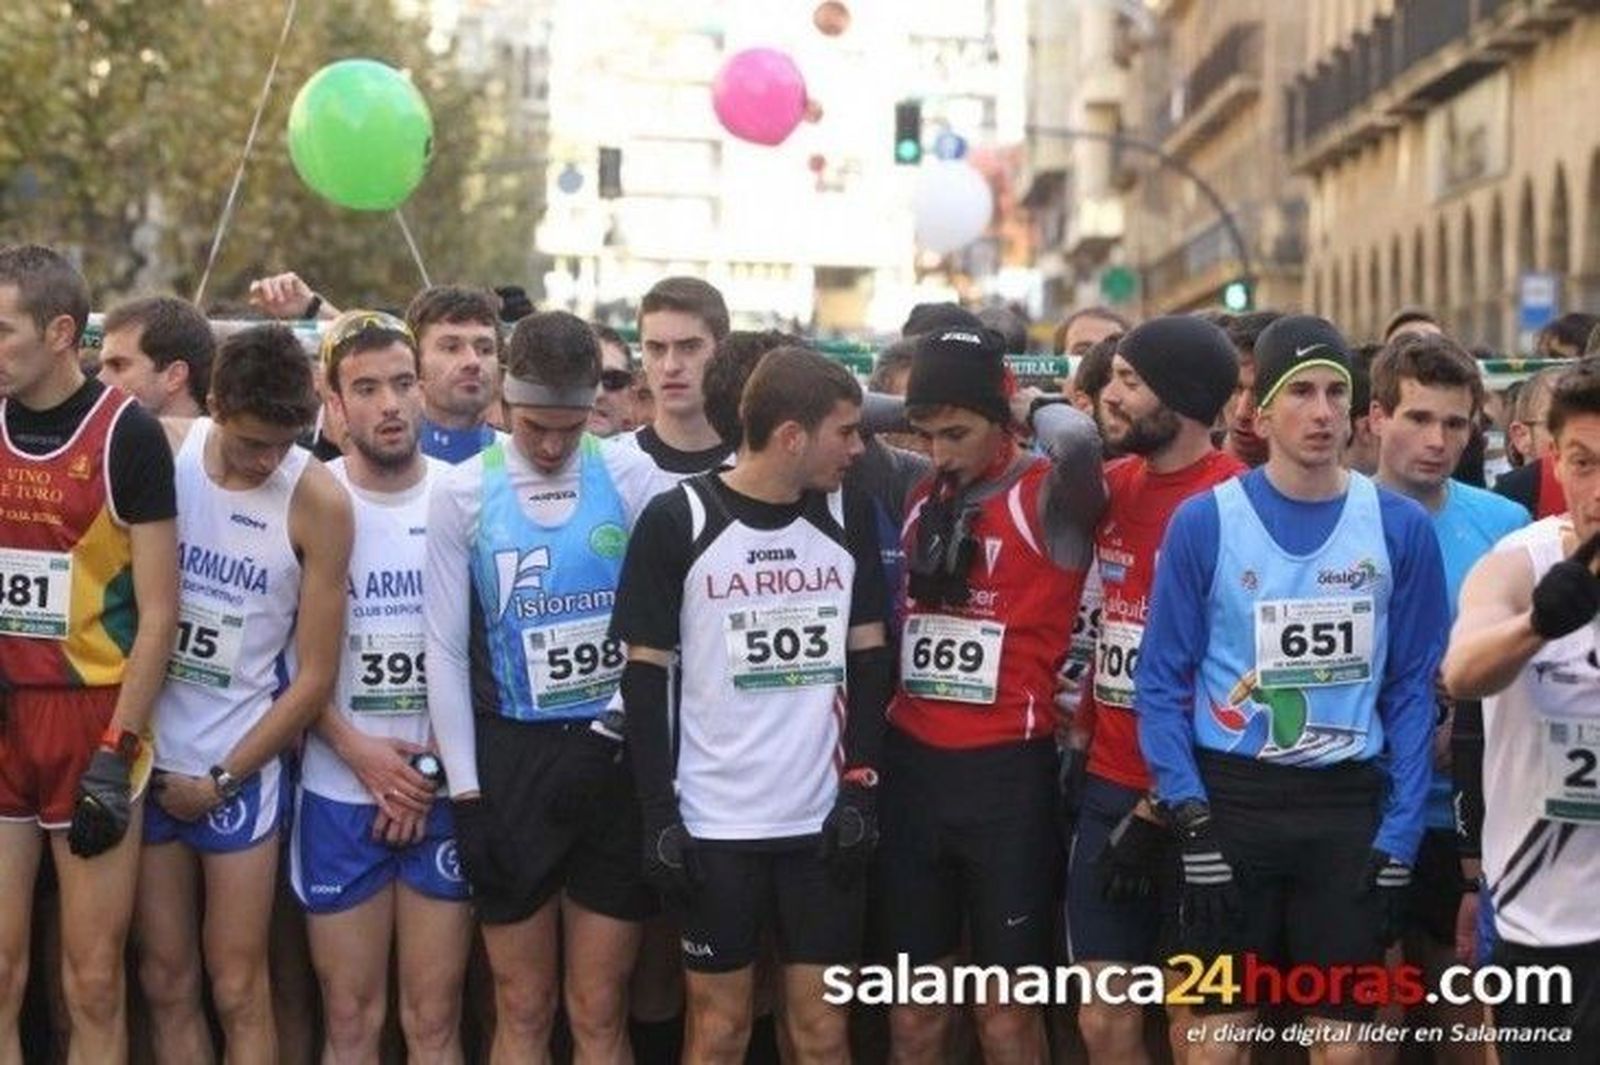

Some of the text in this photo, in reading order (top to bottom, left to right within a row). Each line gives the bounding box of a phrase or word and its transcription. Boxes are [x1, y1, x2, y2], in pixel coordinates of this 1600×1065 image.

[15, 485, 63, 502] TORO
[706, 566, 844, 599] LA RIOJA
[745, 625, 829, 664] 503
[913, 637, 984, 673] 669
[1281, 621, 1353, 658] 651
[547, 639, 623, 680] 598
